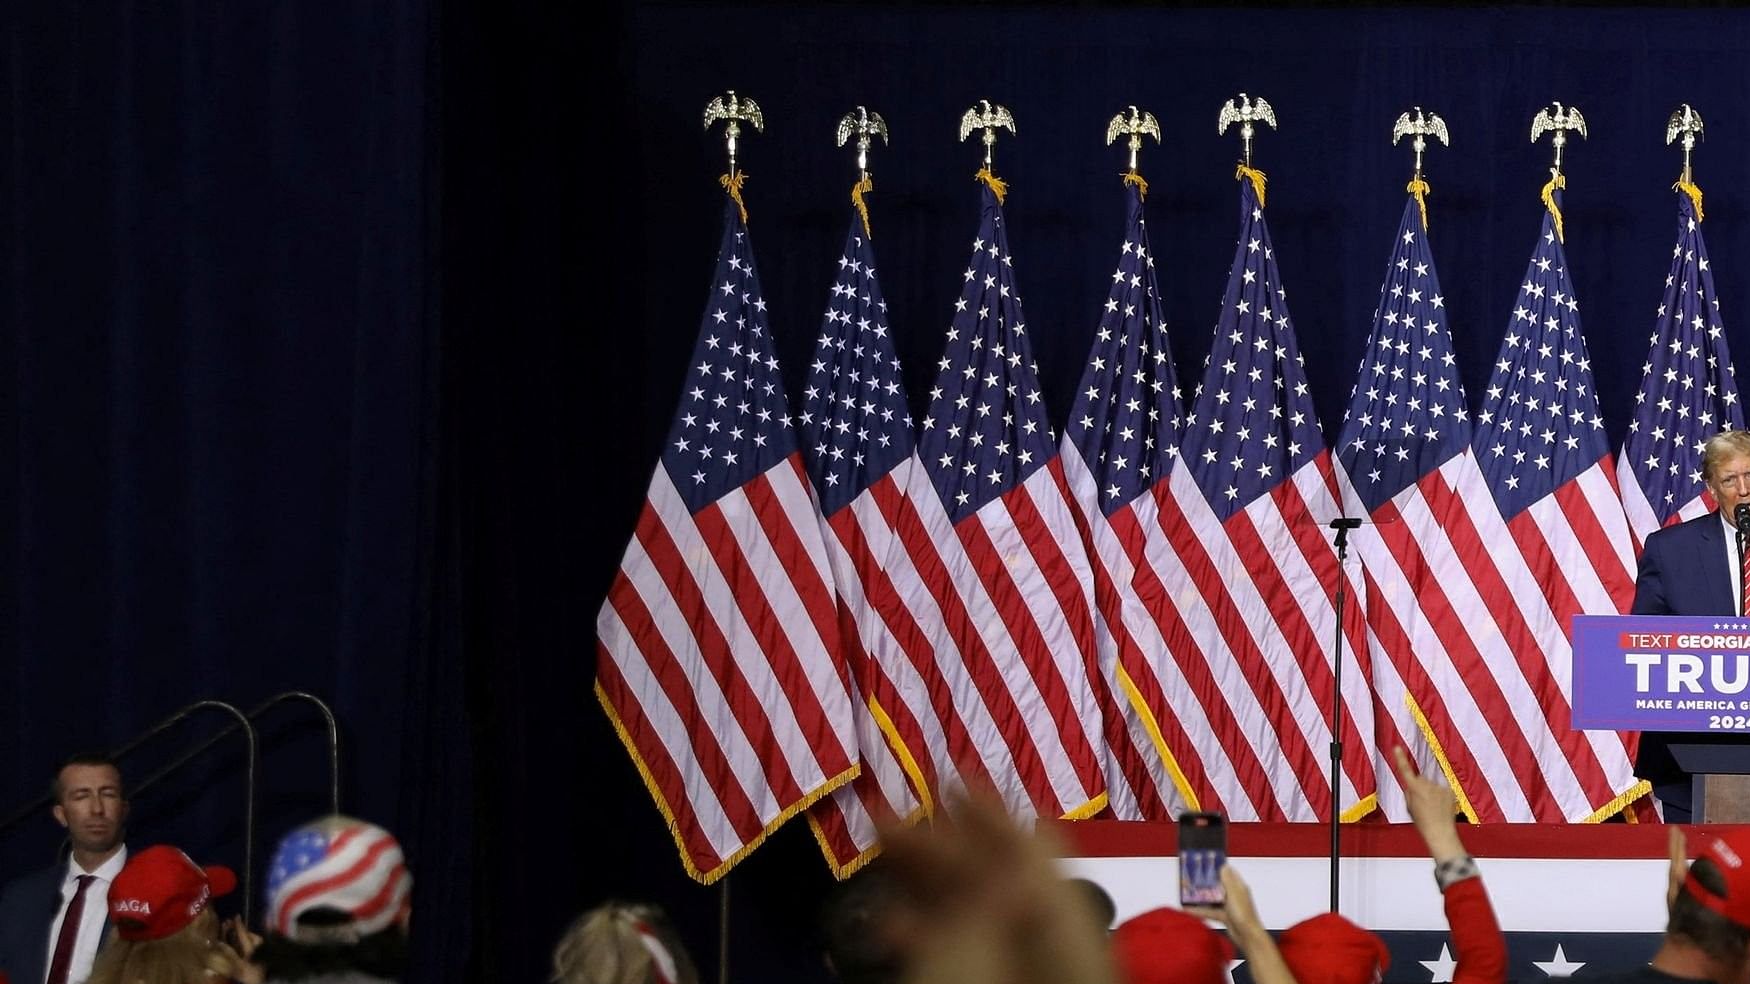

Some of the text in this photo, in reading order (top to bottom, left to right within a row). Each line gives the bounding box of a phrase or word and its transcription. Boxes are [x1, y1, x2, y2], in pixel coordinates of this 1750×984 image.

[1629, 634, 1671, 648] TEXT
[1636, 699, 1673, 710] MAKE
[1677, 700, 1735, 711] AMERICA
